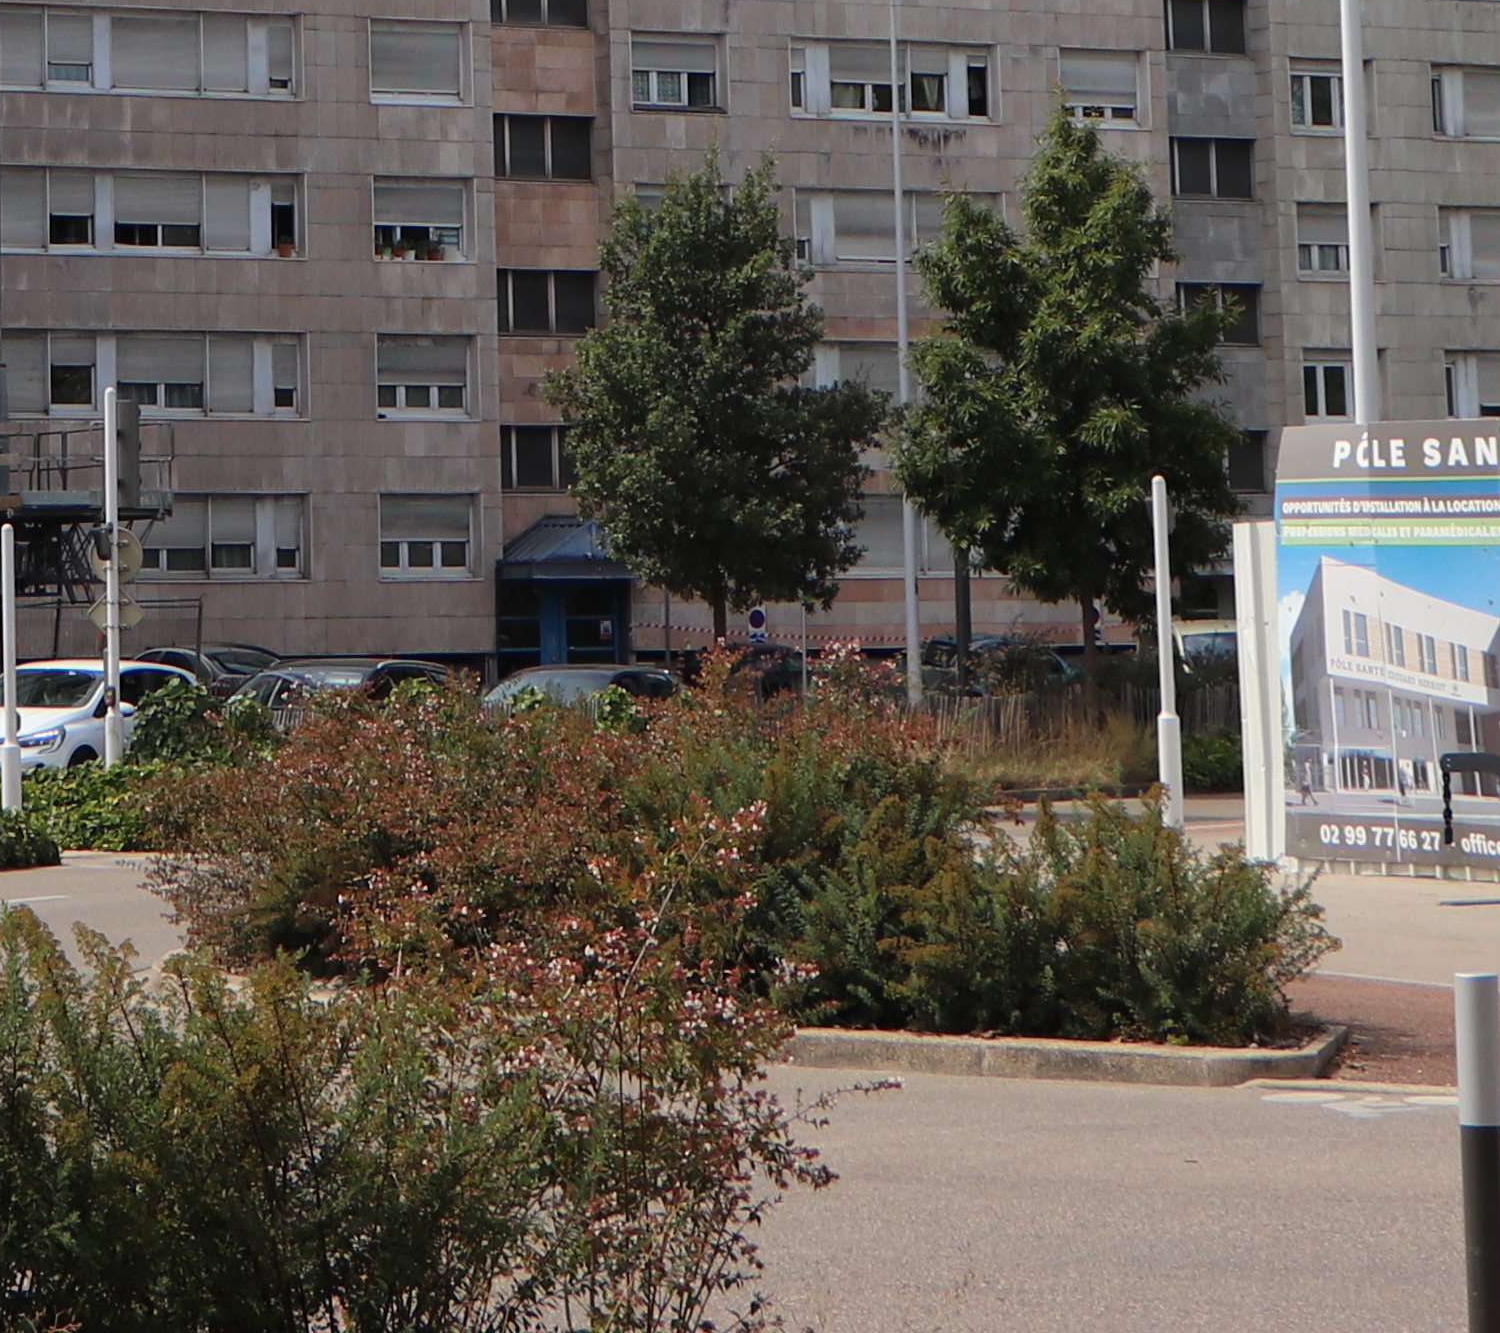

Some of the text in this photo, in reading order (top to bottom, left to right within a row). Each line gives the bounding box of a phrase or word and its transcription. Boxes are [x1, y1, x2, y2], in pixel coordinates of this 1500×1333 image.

[1282, 497, 1351, 514] OPPORTUNITÉS
[1431, 500, 1447, 514] LA
[1399, 525, 1412, 538] ET
[1320, 823, 1341, 845] 02
[1344, 824, 1368, 846] 99
[1370, 825, 1395, 848] 77
[1399, 828, 1418, 850] 66
[1420, 830, 1441, 852] 27
